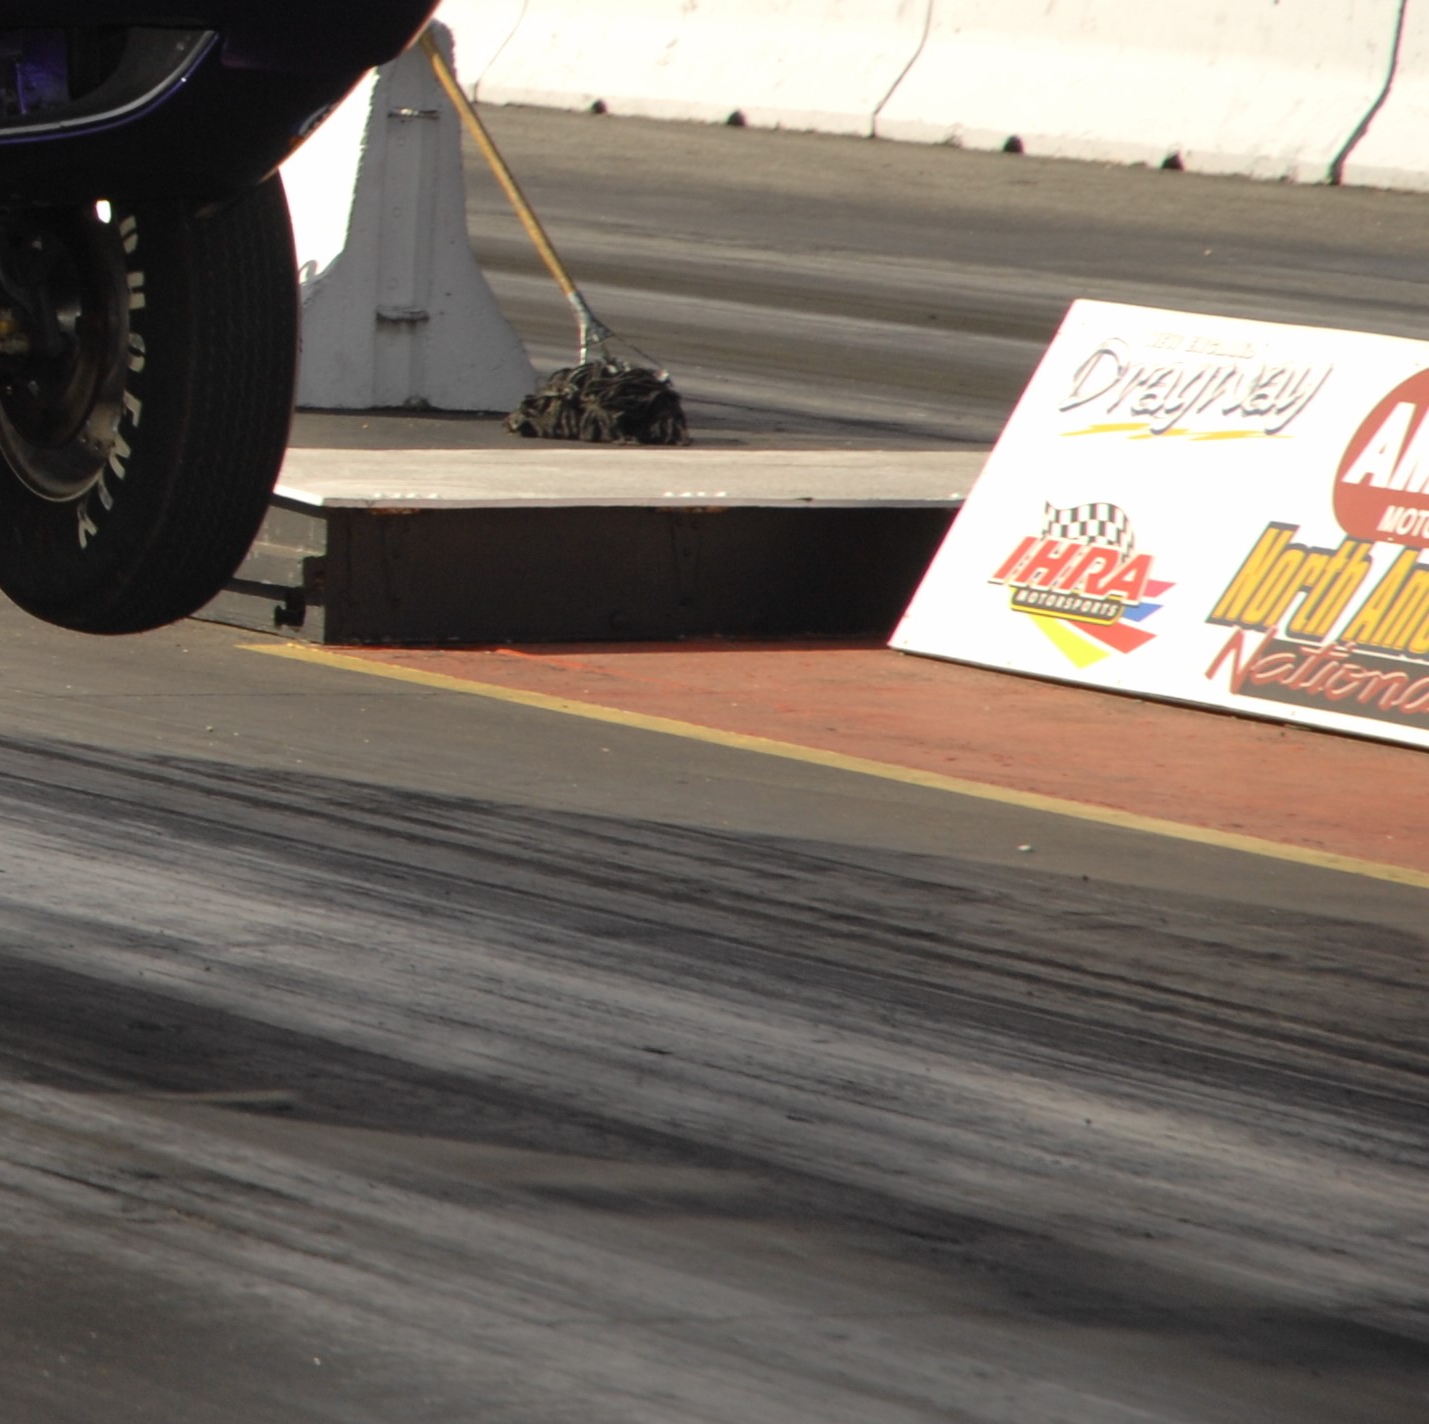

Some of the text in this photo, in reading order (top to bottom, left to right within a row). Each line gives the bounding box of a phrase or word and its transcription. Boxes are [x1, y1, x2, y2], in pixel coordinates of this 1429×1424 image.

[989, 535, 1155, 606] IHRA
[1015, 589, 1120, 618] MOTORSPORTS
[1205, 520, 1373, 643] North
